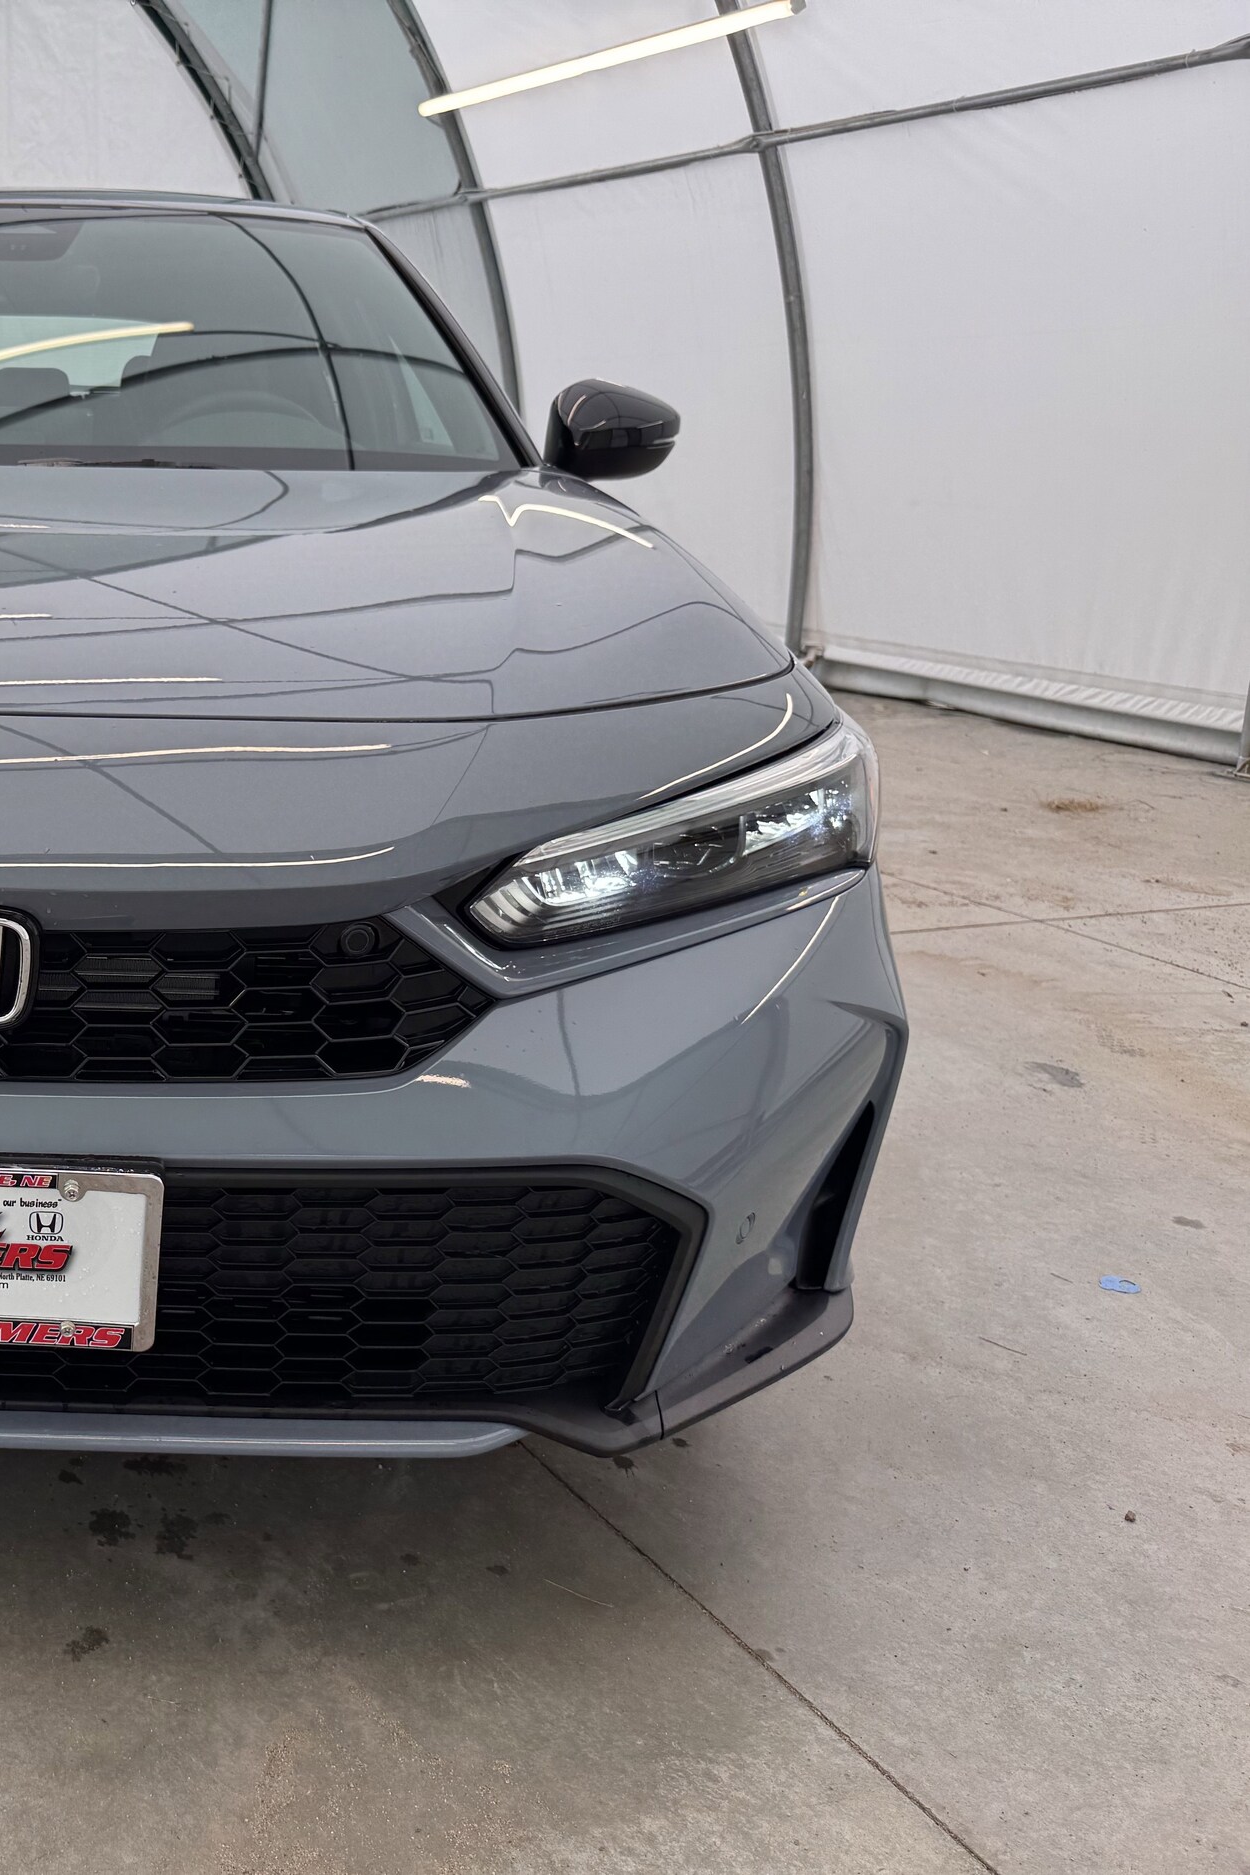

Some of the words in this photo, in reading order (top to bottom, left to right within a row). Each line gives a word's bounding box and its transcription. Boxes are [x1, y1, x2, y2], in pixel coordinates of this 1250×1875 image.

[20, 1175, 52, 1188] NE
[2, 1200, 16, 1208] our
[46, 1274, 66, 1283] 69101
